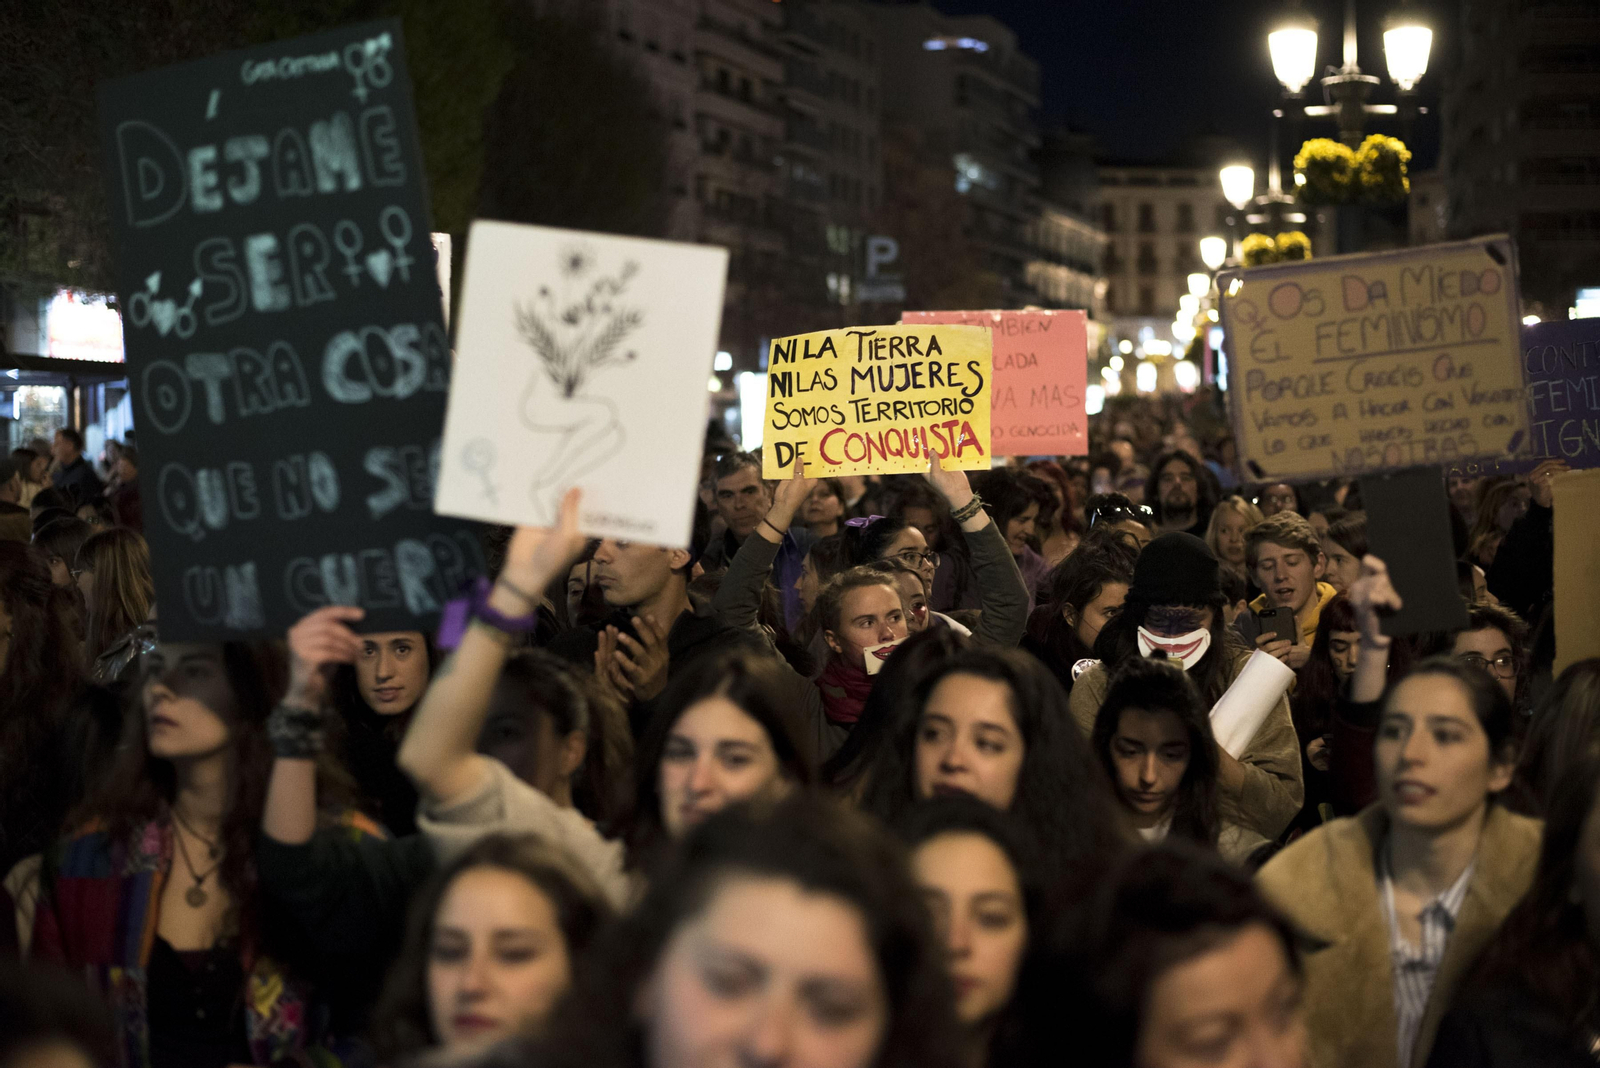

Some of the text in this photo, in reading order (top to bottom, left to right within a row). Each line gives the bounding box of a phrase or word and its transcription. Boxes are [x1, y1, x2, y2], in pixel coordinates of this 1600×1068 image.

[194, 223, 336, 326] SER
[866, 236, 899, 278] P
[773, 330, 942, 364] NI LA TIERRA
[142, 341, 311, 434] OTRA
[771, 361, 984, 397] NI LAS MUJERES
[1030, 385, 1084, 411] MAS
[772, 397, 975, 430] SOMOS TERRITORIO
[1009, 422, 1080, 440] GENOCIDA
[774, 419, 985, 468] DE CONQUISTA
[158, 461, 261, 541] QUE
[273, 451, 341, 521] NO
[184, 561, 265, 630] UN
